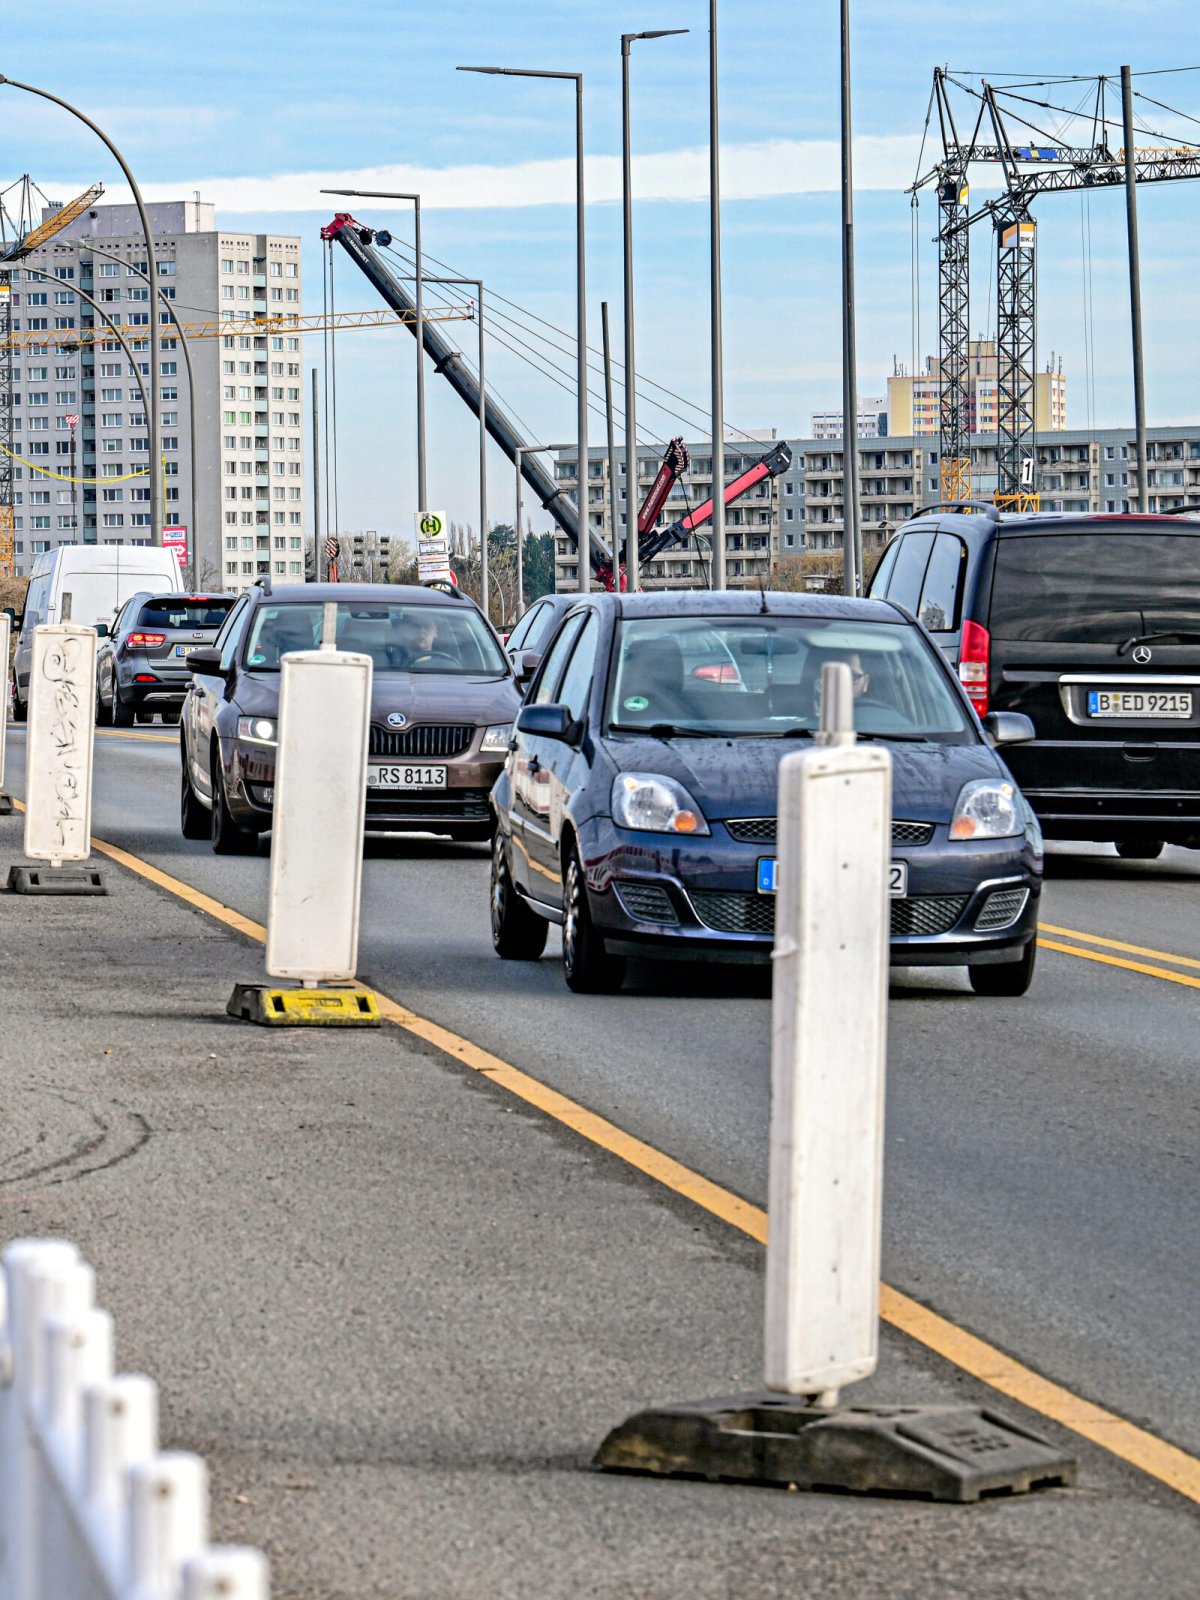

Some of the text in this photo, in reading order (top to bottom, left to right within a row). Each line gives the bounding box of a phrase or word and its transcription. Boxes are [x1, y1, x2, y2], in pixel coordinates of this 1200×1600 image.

[1025, 461, 1031, 481] 1
[1100, 694, 1110, 711] B
[1122, 694, 1144, 711] ED
[1148, 695, 1189, 712] 9215
[379, 767, 444, 785] RS 8113
